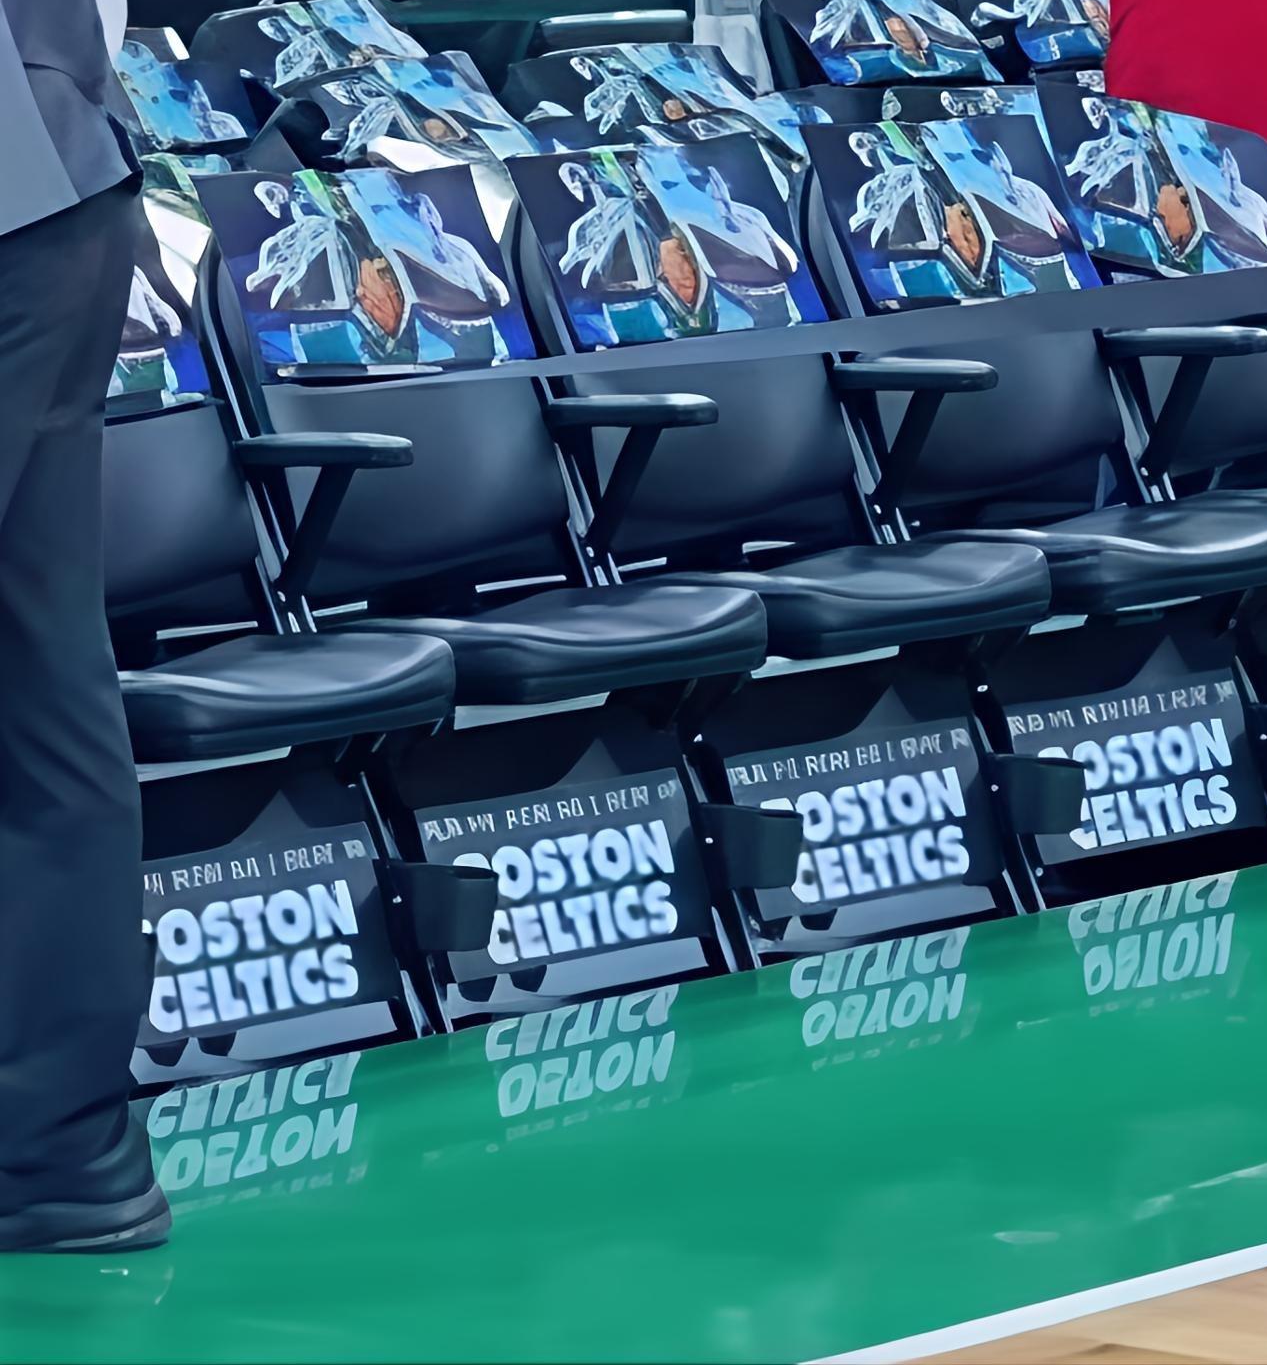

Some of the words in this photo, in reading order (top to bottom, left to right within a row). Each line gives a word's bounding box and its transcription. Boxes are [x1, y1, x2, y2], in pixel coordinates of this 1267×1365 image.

[1038, 718, 1232, 790] OSTON
[760, 767, 966, 842] OSTON
[453, 820, 674, 899] OSTON
[142, 880, 358, 965] OSTON
[149, 943, 358, 1033] CELTICS
